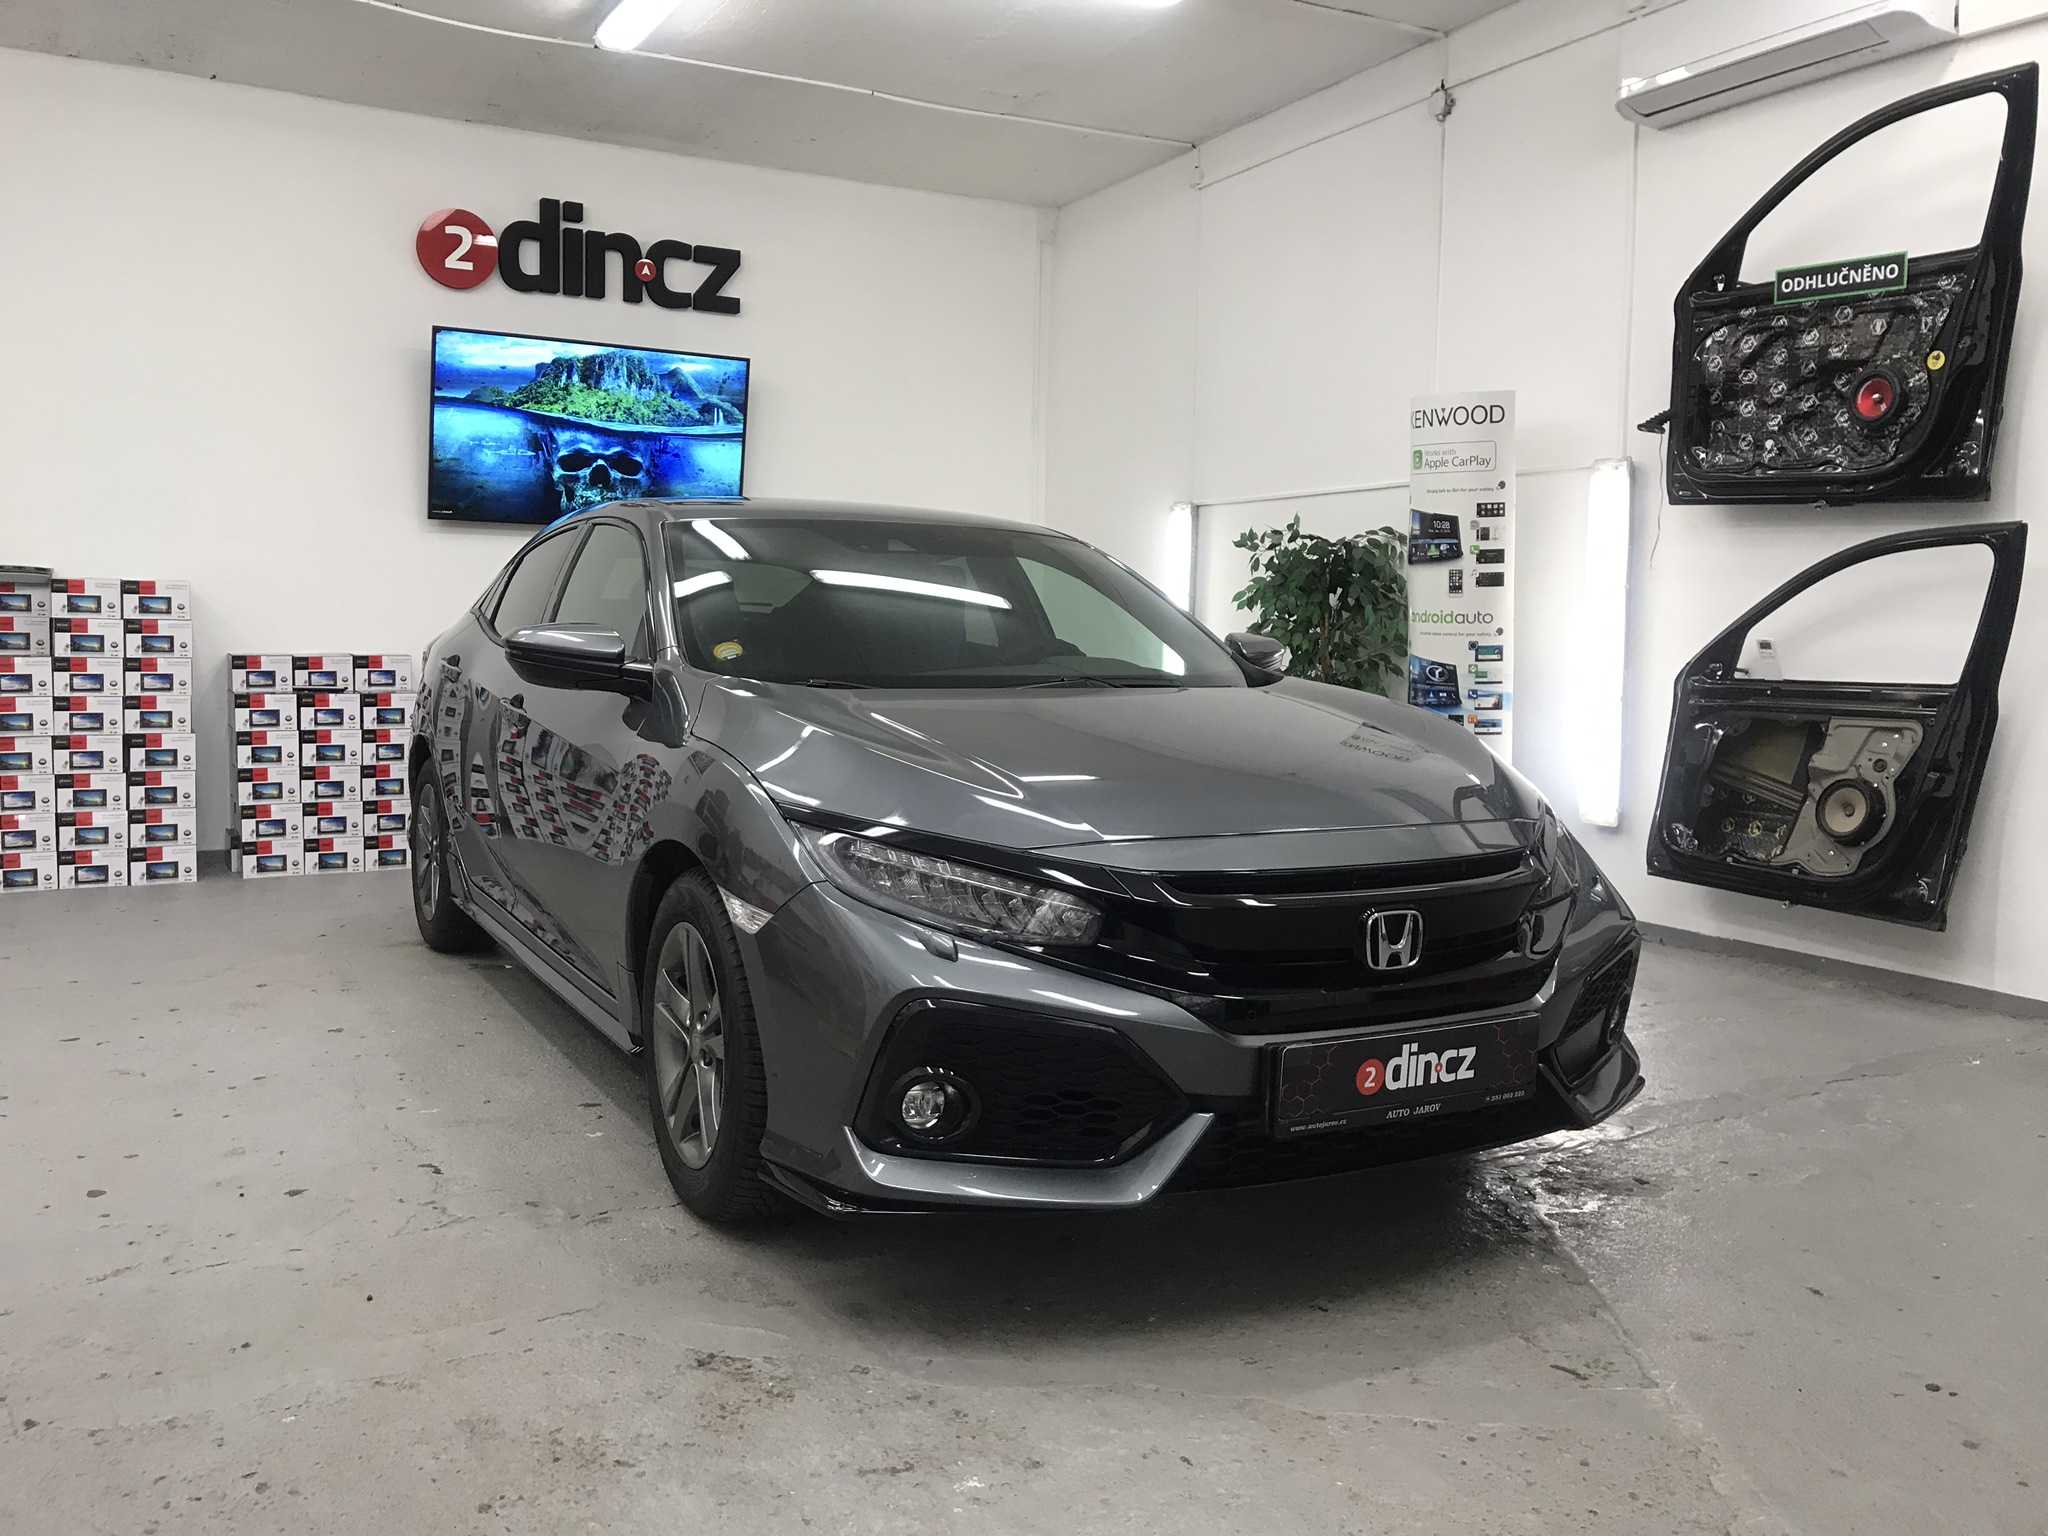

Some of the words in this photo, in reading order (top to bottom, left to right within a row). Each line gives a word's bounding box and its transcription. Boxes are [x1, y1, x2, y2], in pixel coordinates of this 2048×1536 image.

[1781, 263, 1899, 293] ODHLUČNĚNO
[1424, 456, 1449, 470] Apple
[1451, 455, 1491, 468] CarPlay
[1386, 1108, 1410, 1119] AUTO
[1413, 1103, 1441, 1115] JAROV
